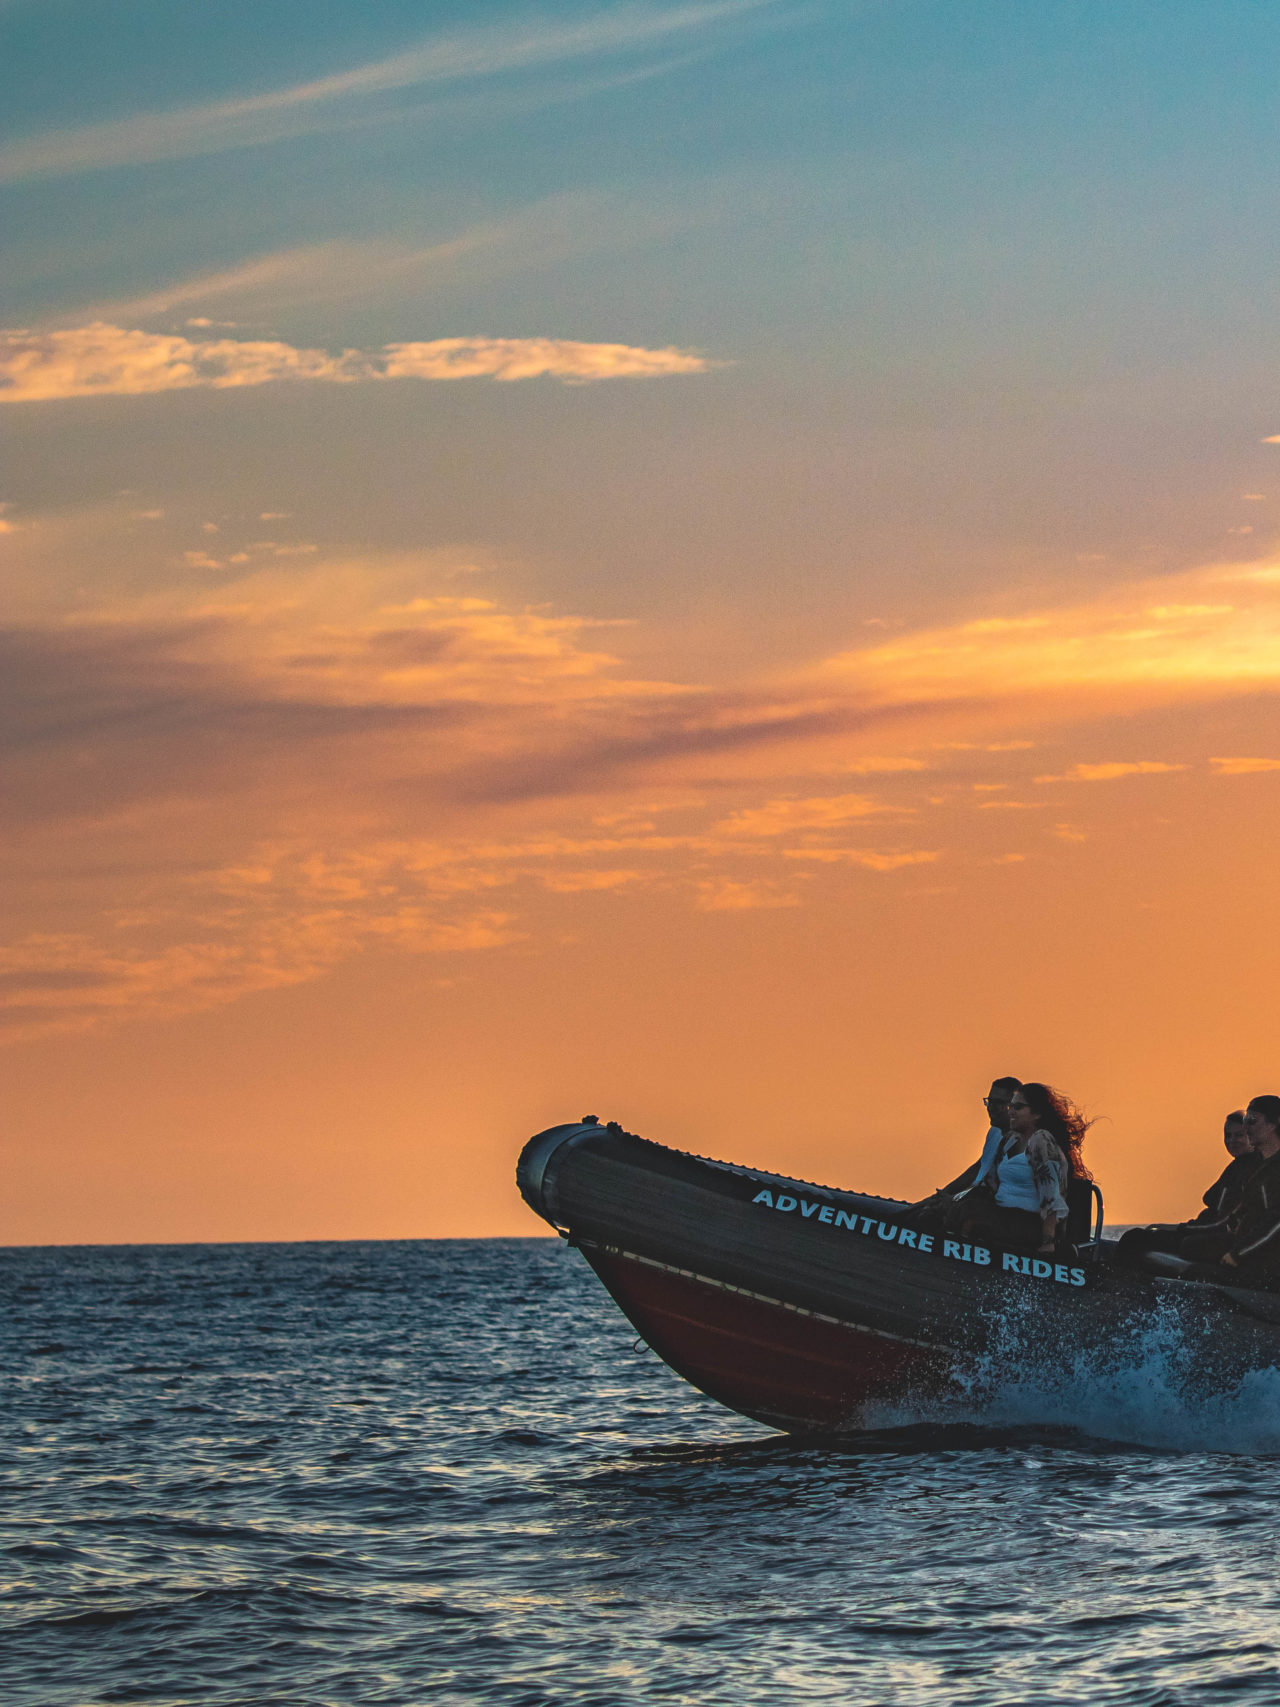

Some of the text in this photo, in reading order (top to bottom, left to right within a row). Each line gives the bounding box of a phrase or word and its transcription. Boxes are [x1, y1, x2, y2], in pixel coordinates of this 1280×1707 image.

[752, 1189, 1086, 1287] ADVENTURE RIB RIDES
